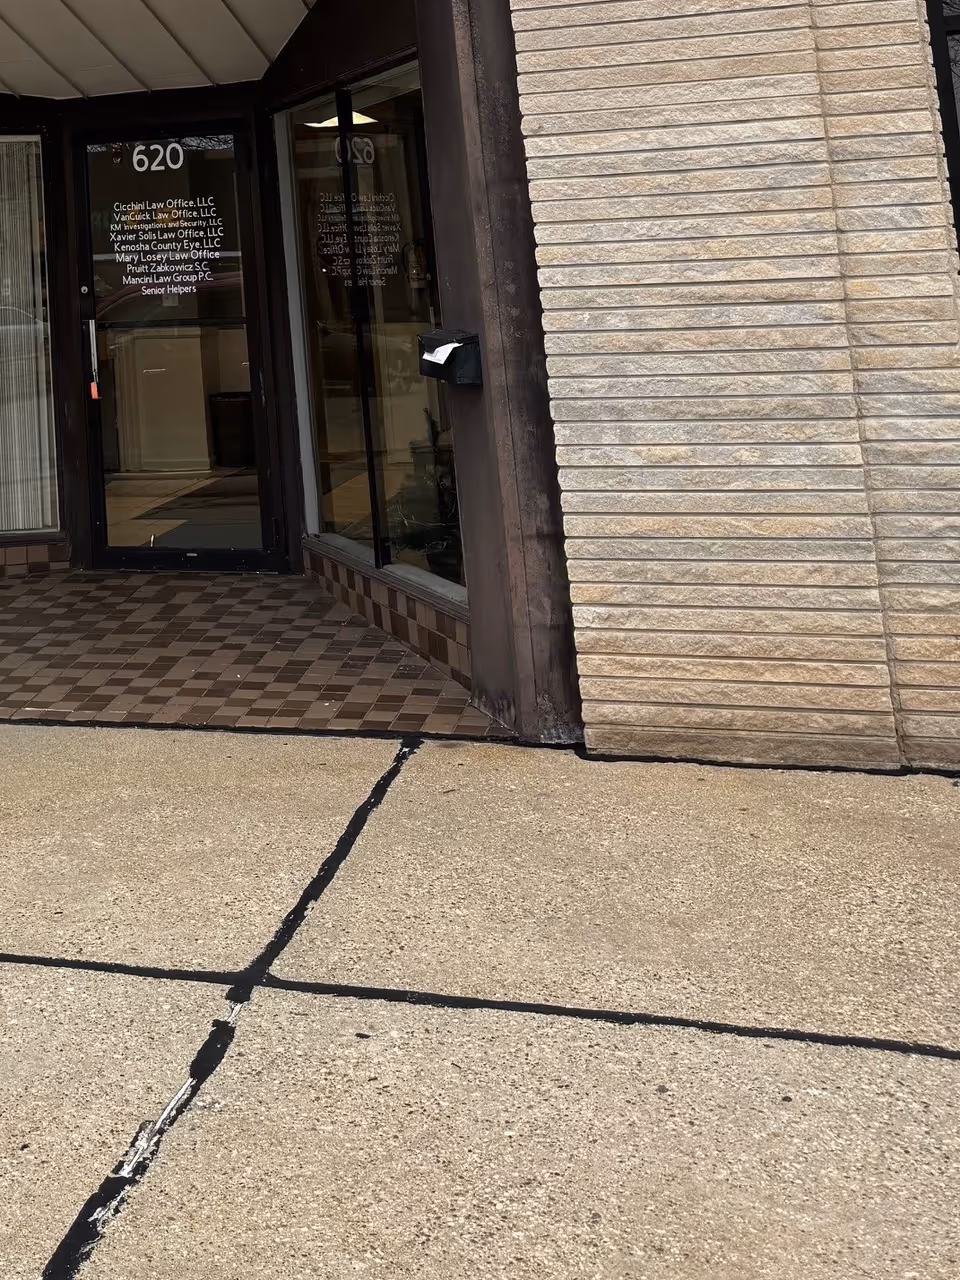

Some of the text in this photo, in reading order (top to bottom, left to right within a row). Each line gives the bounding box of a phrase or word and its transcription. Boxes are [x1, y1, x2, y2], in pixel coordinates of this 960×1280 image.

[132, 143, 184, 172] 620
[114, 202, 145, 211] Cicchini
[146, 201, 164, 209] Law
[197, 197, 214, 206] LLC
[153, 211, 169, 220] Law
[201, 208, 216, 217] LLC
[124, 222, 166, 230] Investigations
[209, 218, 222, 226] LLC
[110, 232, 136, 241] Xavier
[139, 232, 156, 240] Solis
[158, 231, 175, 239] Law
[208, 228, 224, 236] LLC
[114, 243, 149, 251] Kenosha
[151, 241, 181, 251] County
[204, 238, 221, 248] LLC
[116, 250, 219, 263] Mary Losey Law Office
[127, 264, 148, 273] Pruitt
[151, 263, 193, 272] Zabkowicz
[123, 275, 152, 285] Mancini
[154, 274, 171, 283] Law
[173, 273, 197, 282] Group
[142, 285, 197, 295] Senior Helpers
